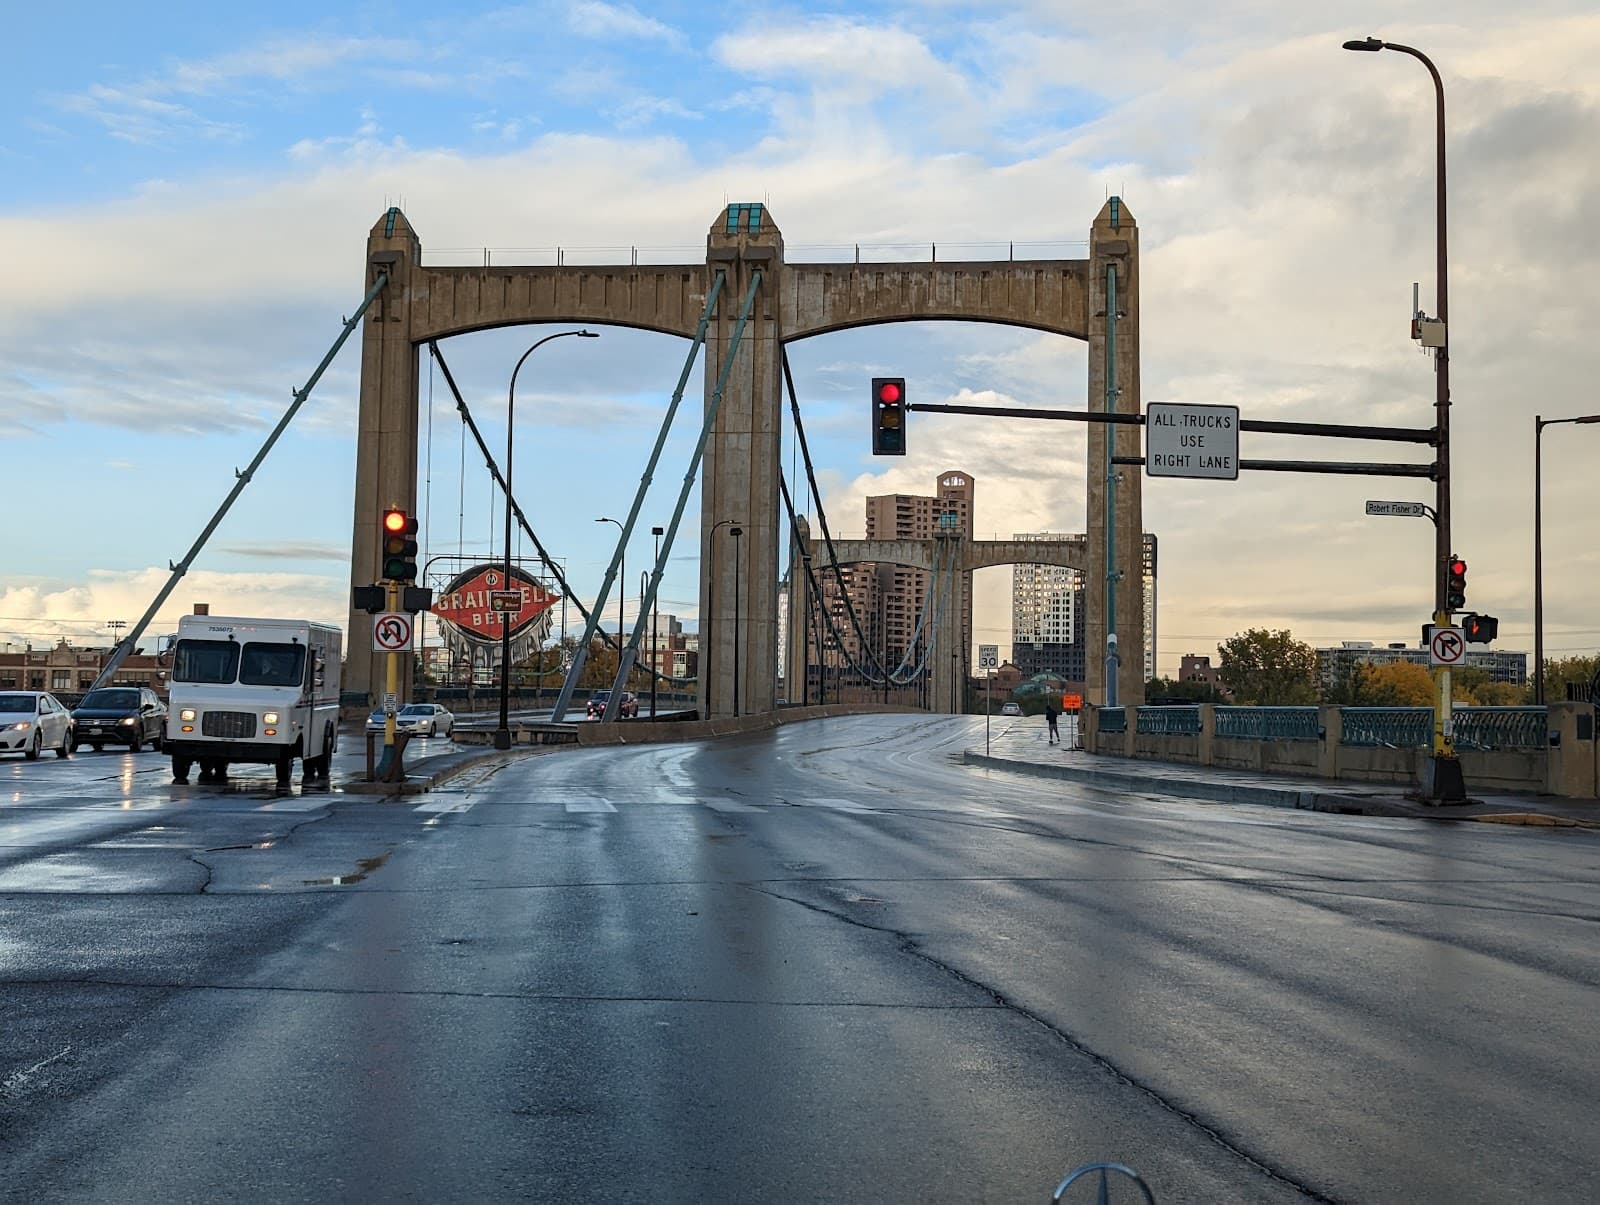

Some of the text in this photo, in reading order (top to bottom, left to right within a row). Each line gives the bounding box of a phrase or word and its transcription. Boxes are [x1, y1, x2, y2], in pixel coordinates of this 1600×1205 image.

[1154, 413, 1231, 429] ALL TRUCKS
[1180, 434, 1205, 448] USE
[1154, 454, 1231, 469] RIGHT LANE
[1368, 503, 1389, 513] Robert
[1391, 504, 1410, 513] Fisher
[981, 657, 996, 667] 30
